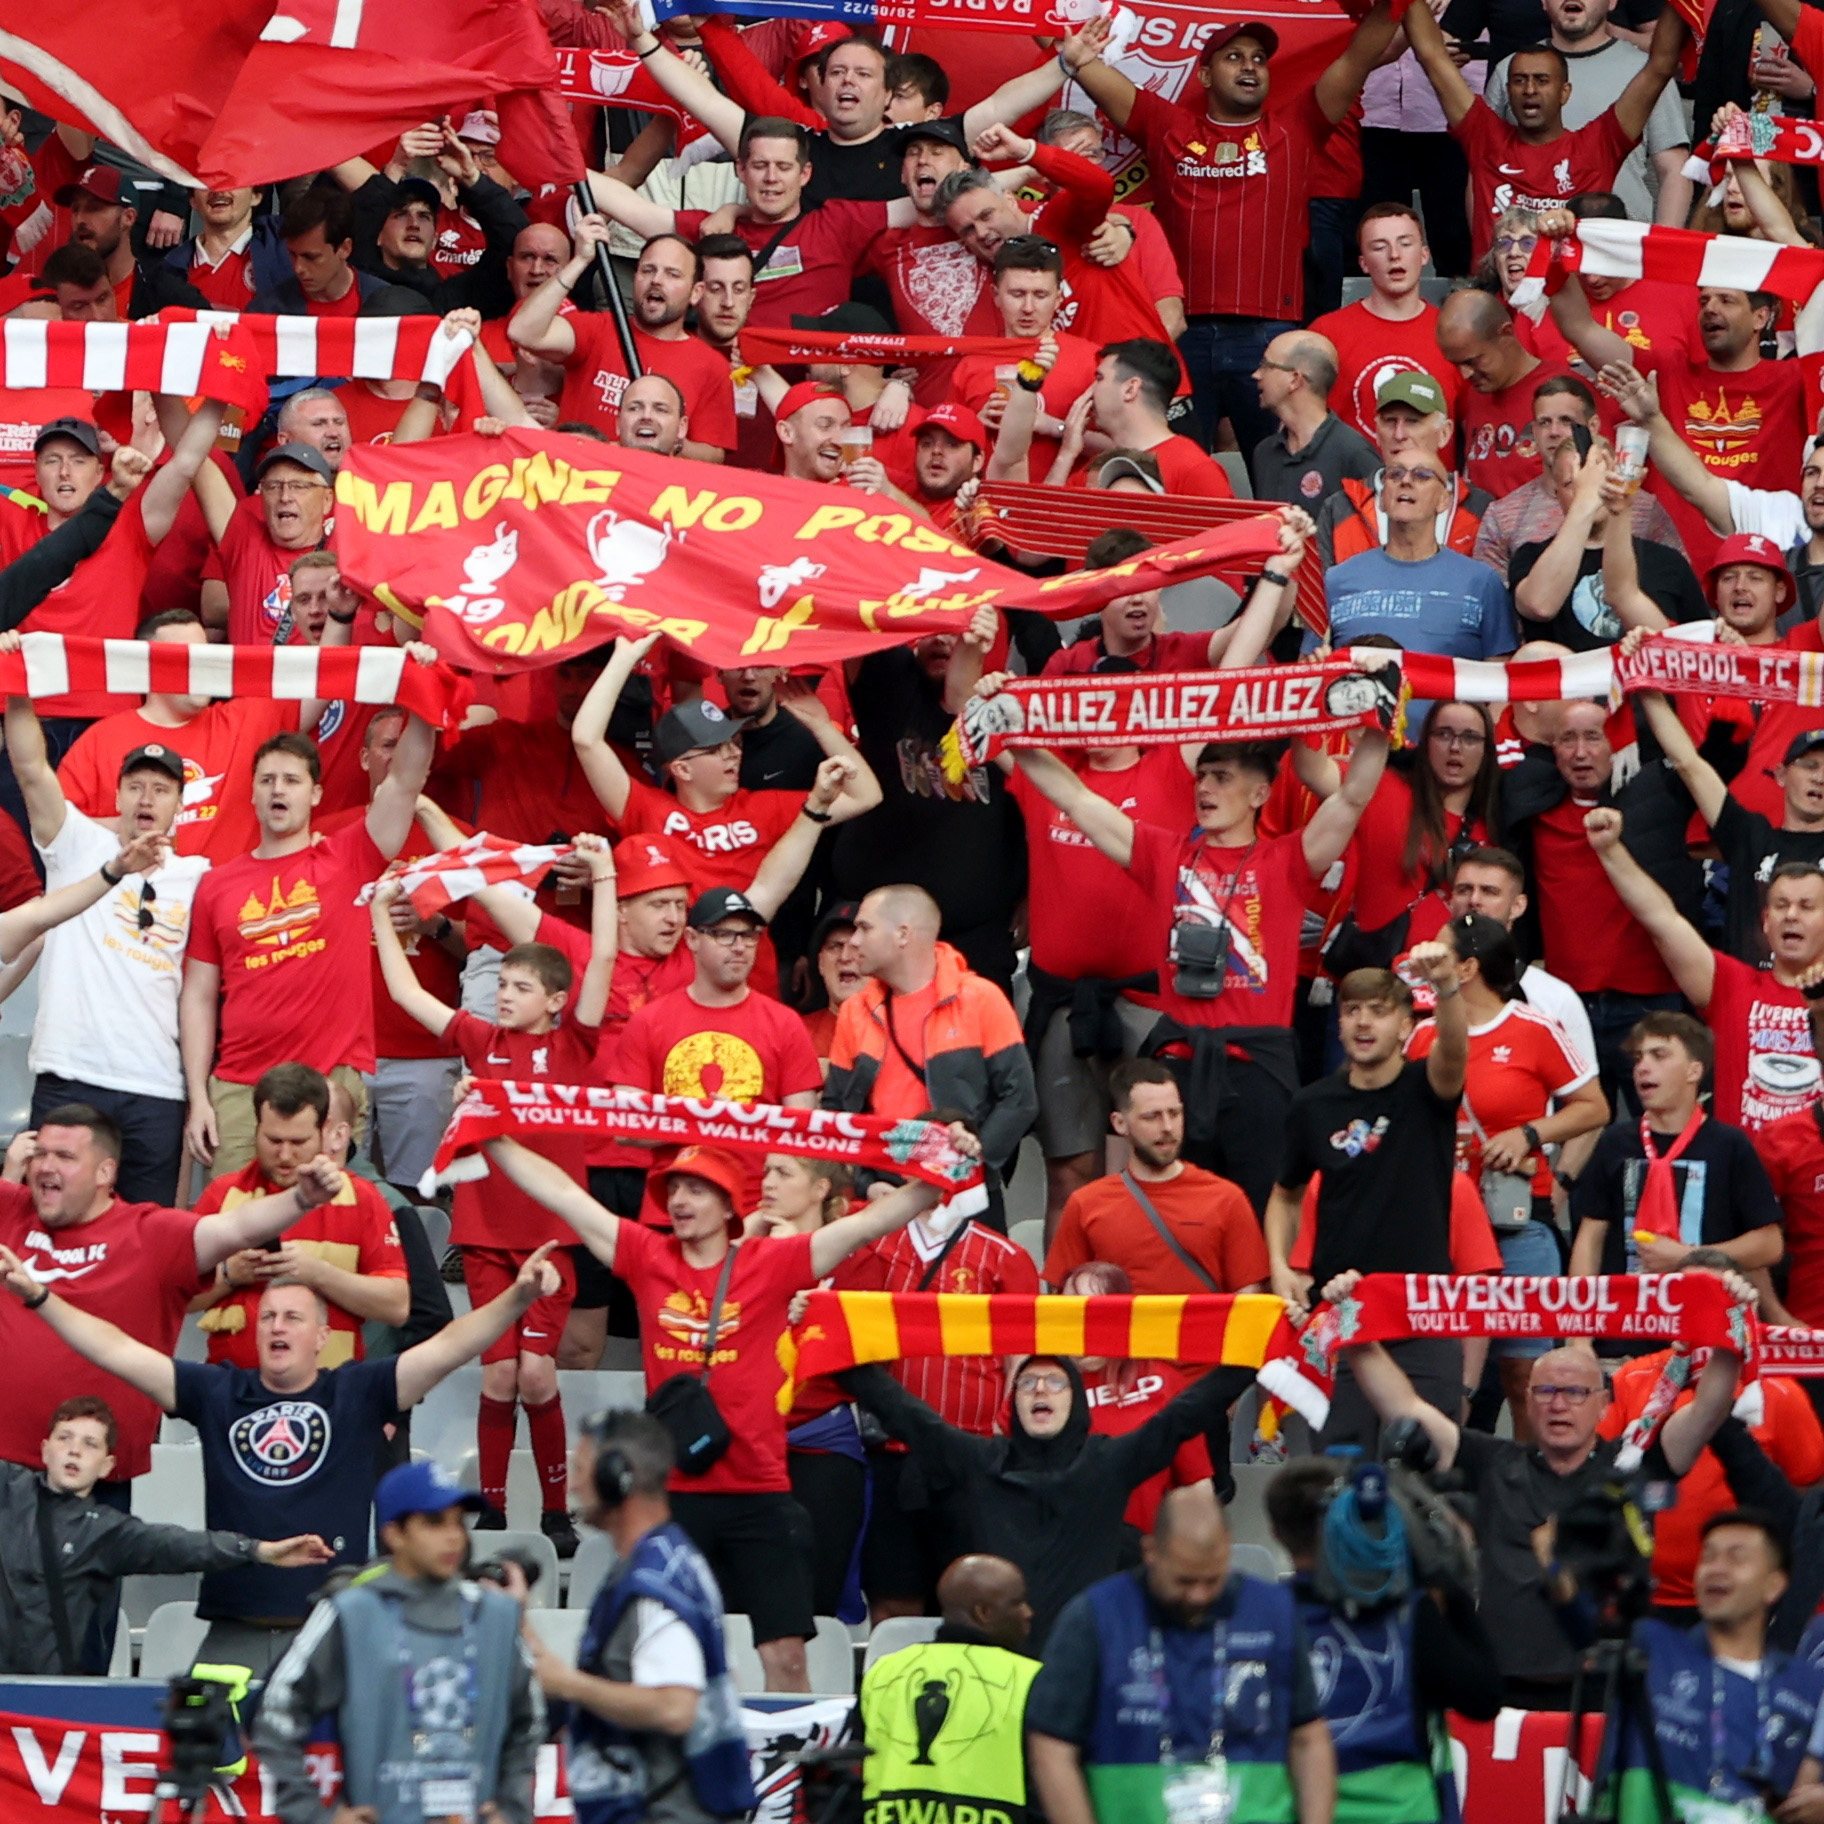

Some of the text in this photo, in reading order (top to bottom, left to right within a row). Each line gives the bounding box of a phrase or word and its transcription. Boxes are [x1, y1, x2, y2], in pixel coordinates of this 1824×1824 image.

[1178, 163, 1244, 177] Chartered
[1704, 453, 1758, 467] rouges
[649, 486, 762, 531] NO
[1618, 644, 1792, 689] LIVERPOOL FC
[1028, 677, 1322, 732] ALLEZ ALLEZ ALLEZ
[272, 939, 325, 963] rouges
[512, 1107, 860, 1153] YOU'LL NEVER WALK ALONE
[1404, 1273, 1684, 1313] LIVERPOOL FC
[1408, 1312, 1680, 1334] YOU'LL NEVER WALK ALONE
